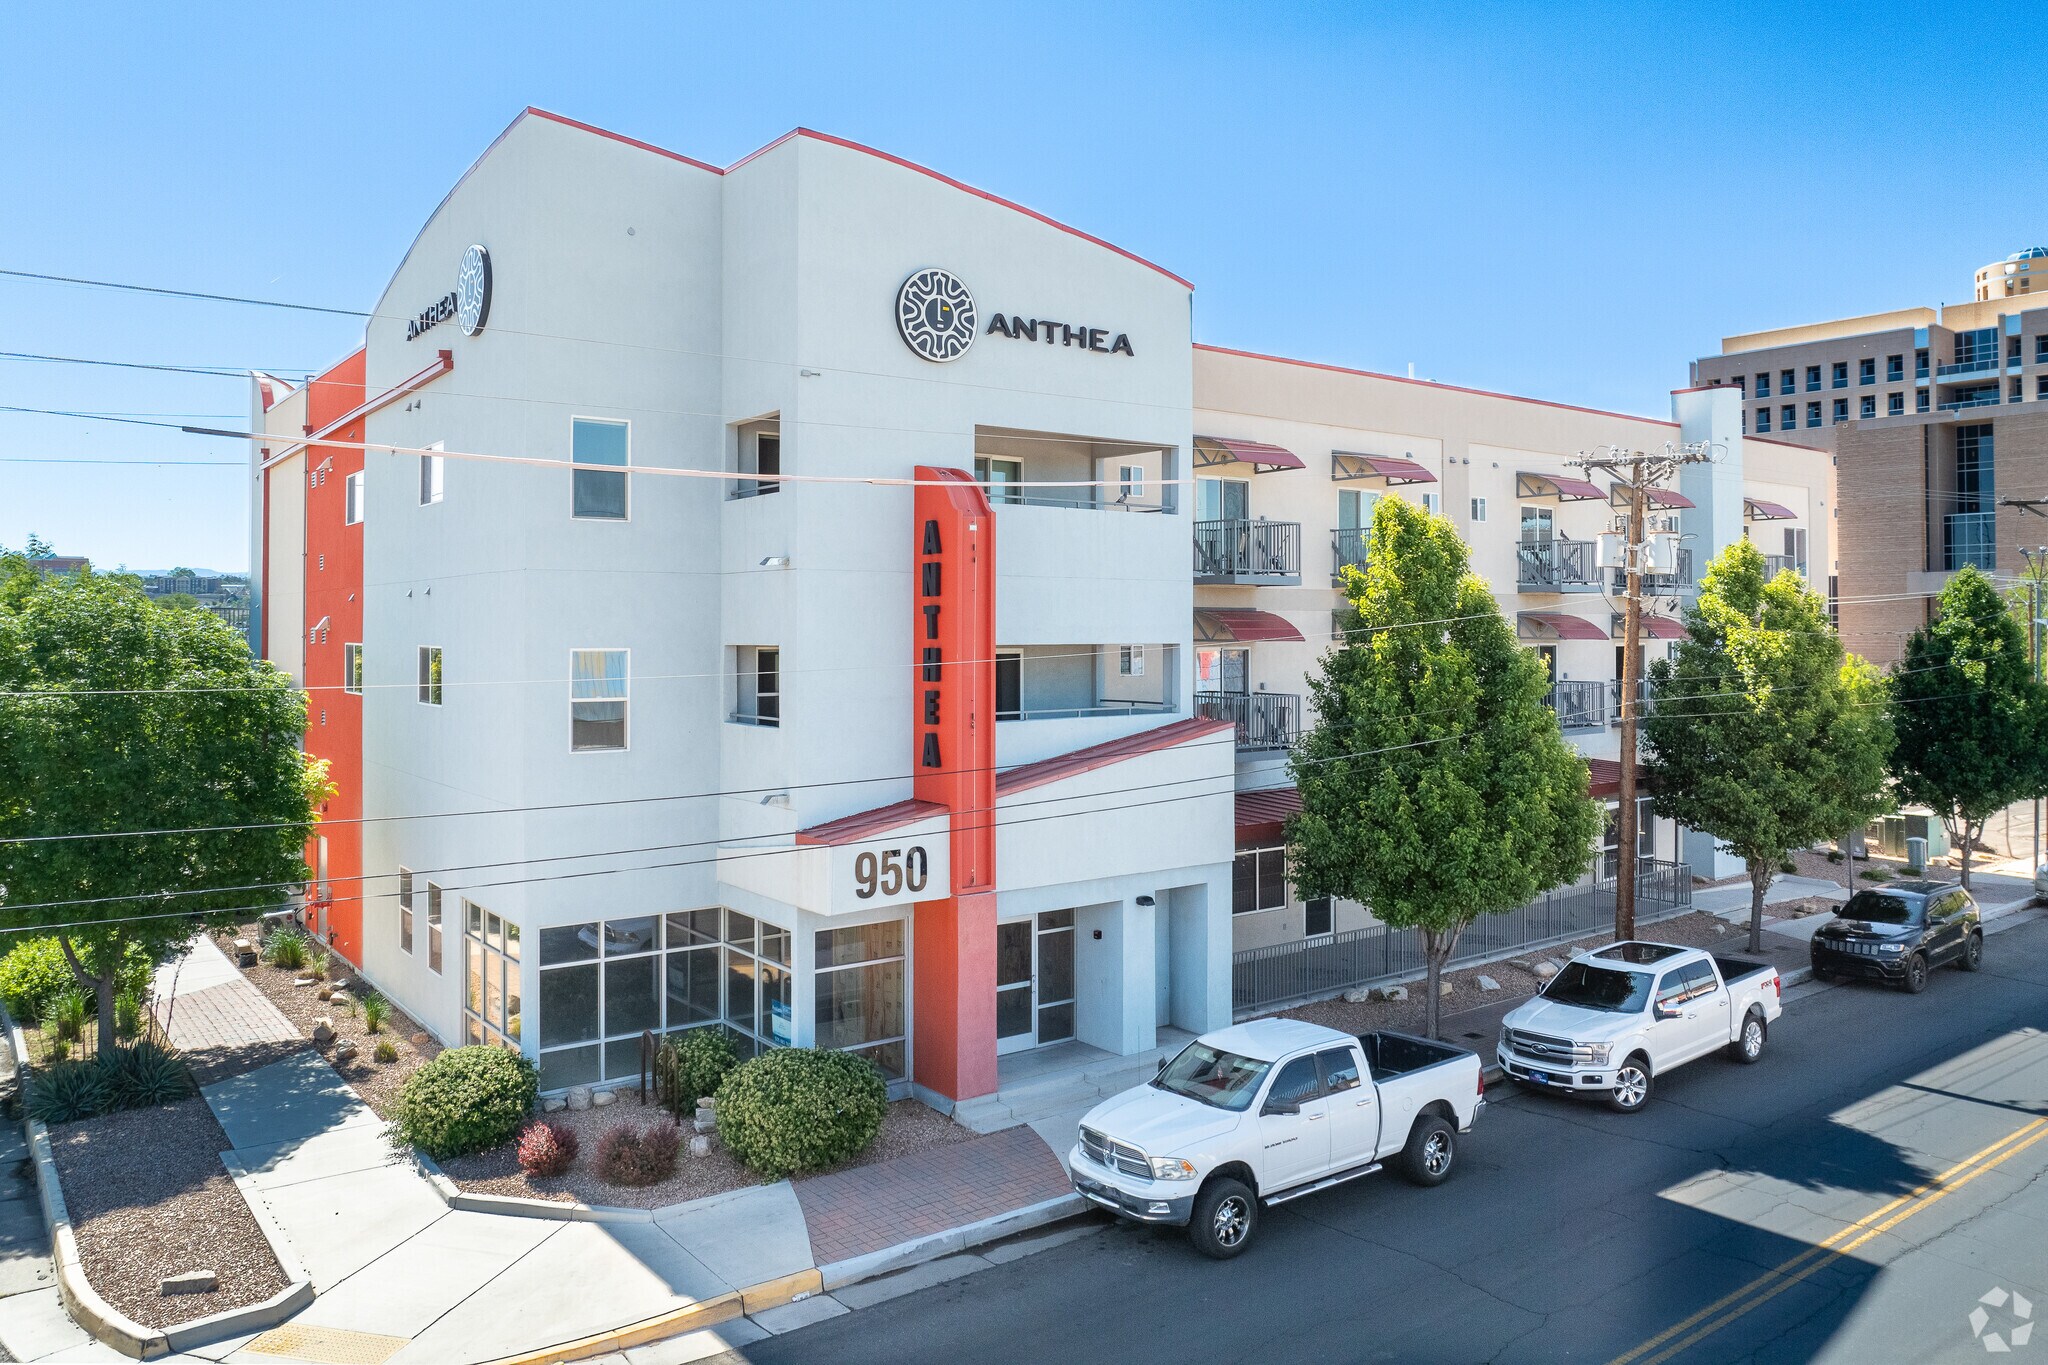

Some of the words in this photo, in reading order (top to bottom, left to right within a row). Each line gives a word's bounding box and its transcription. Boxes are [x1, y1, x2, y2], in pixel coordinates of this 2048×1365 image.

[406, 291, 457, 341] ANTHEA
[985, 312, 1135, 357] ANTHEA
[922, 519, 942, 768] ANTHEA
[855, 846, 928, 899] 950
